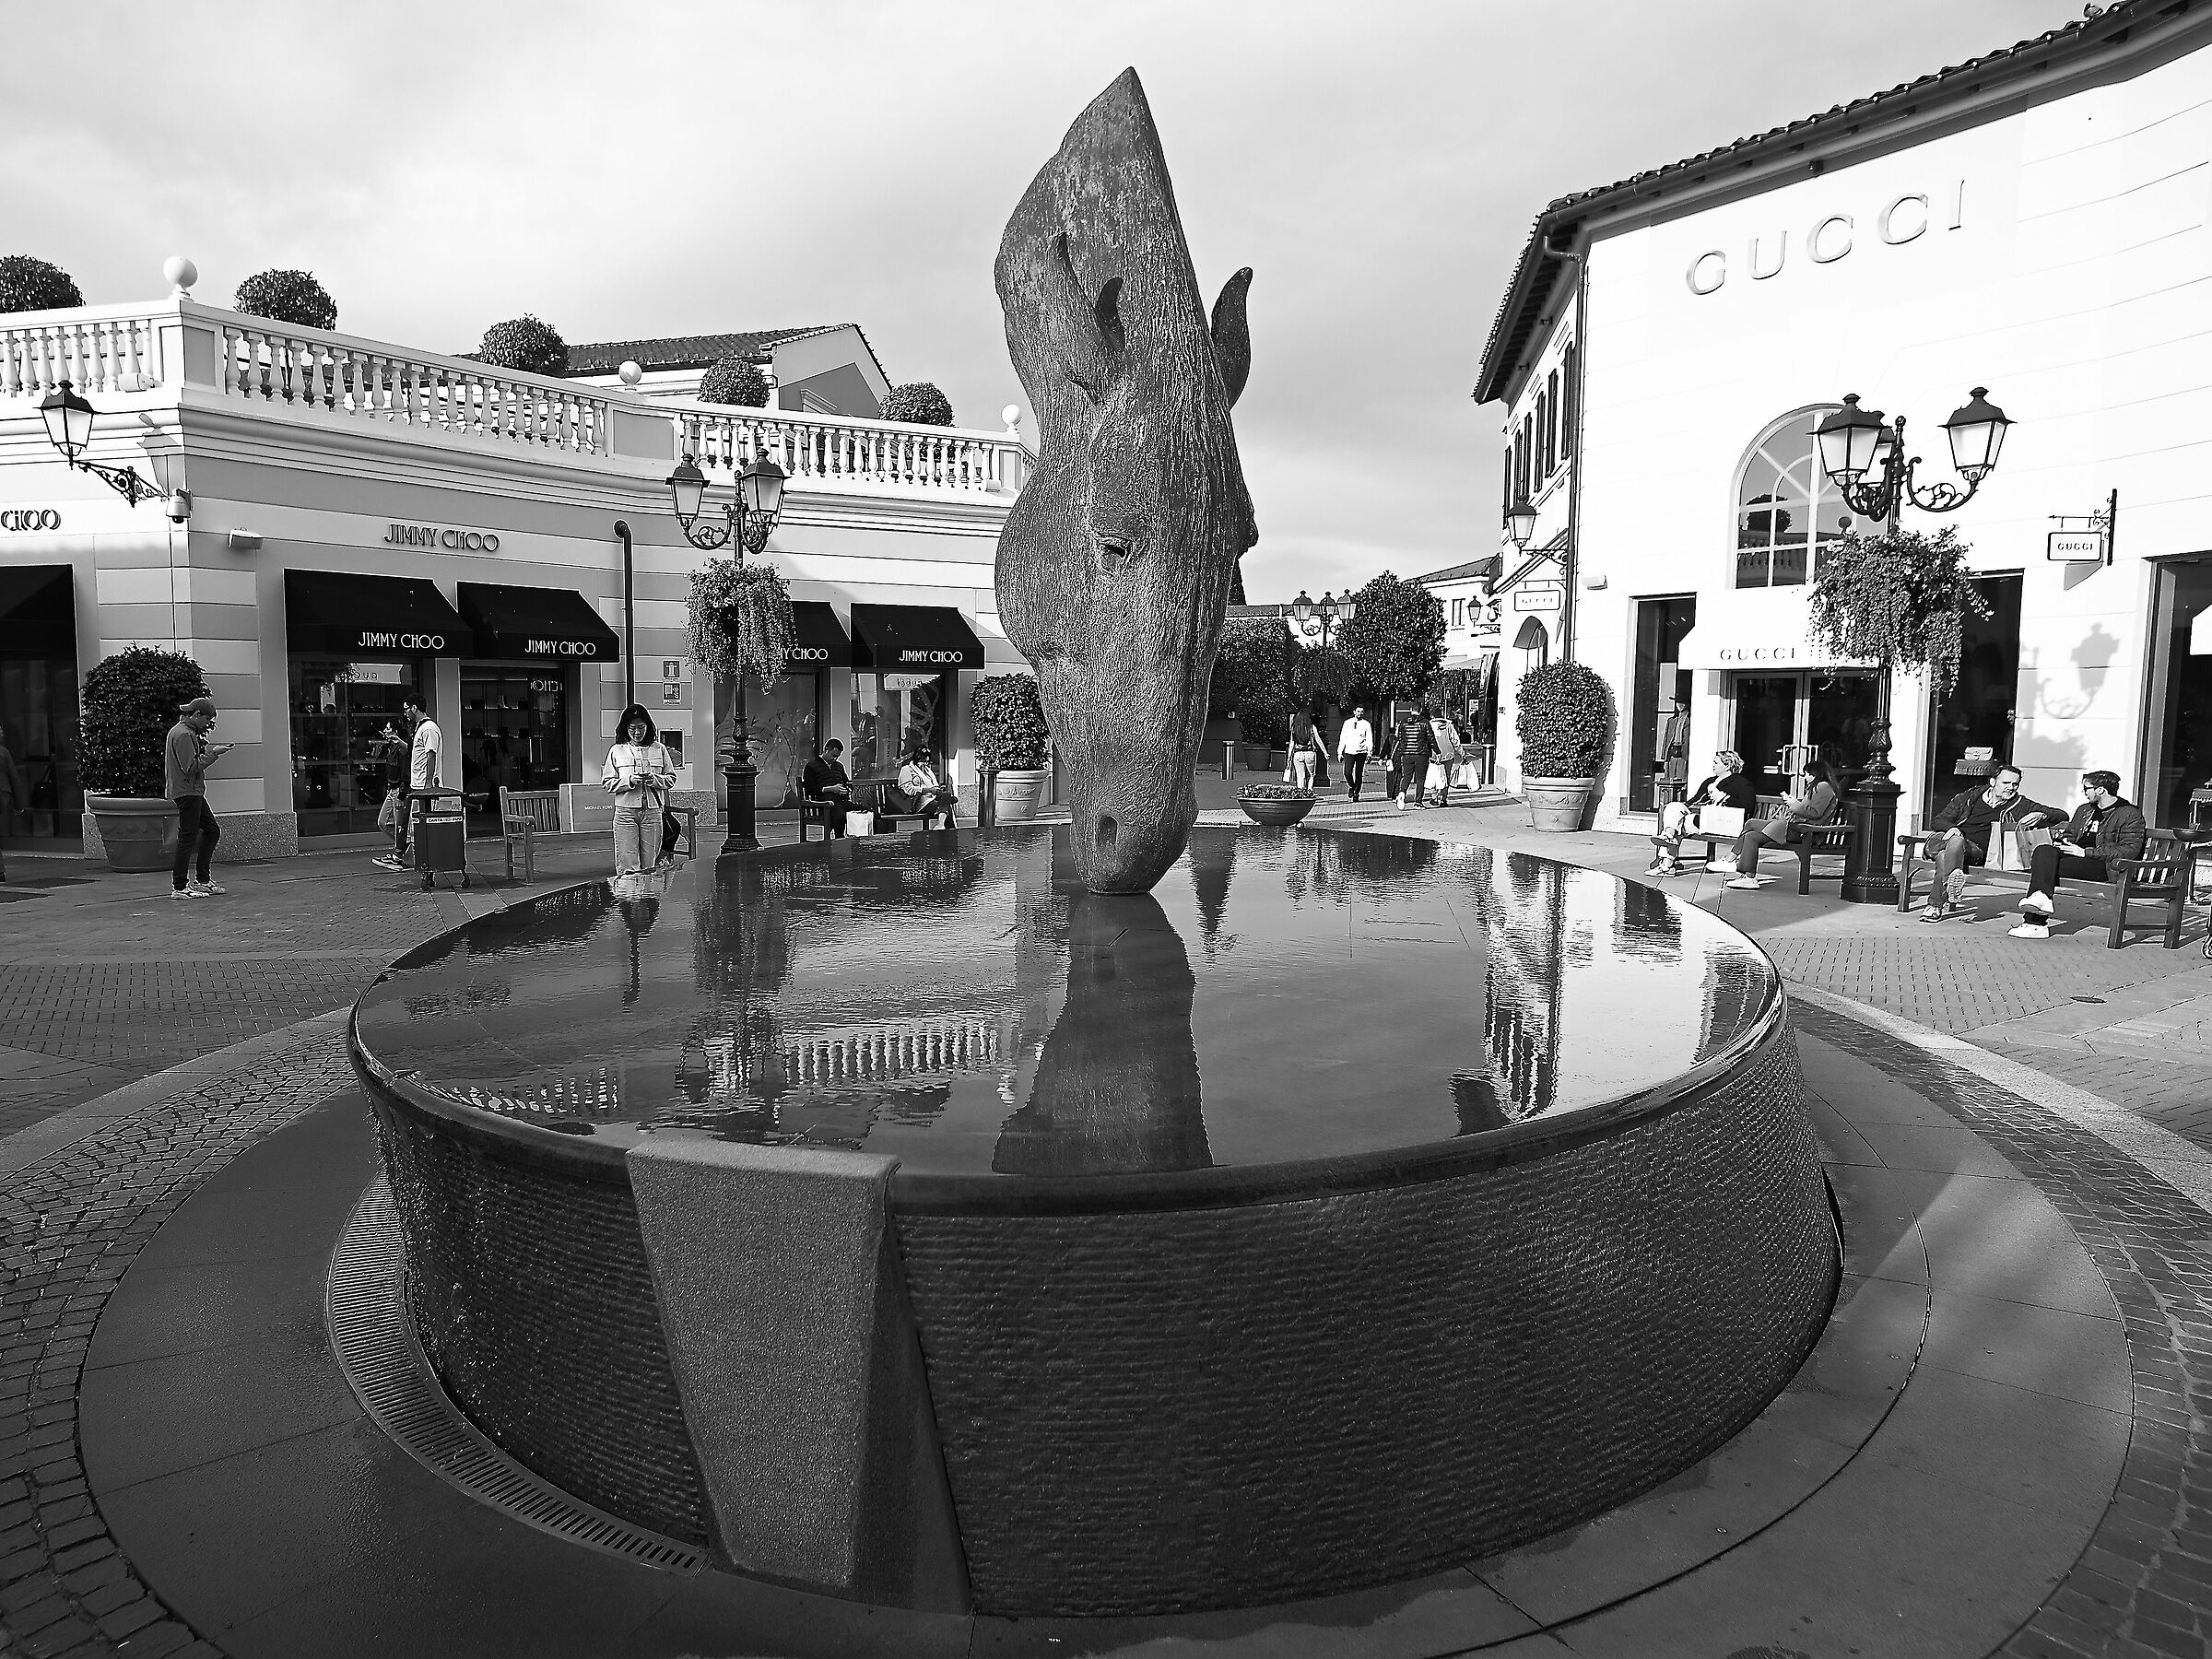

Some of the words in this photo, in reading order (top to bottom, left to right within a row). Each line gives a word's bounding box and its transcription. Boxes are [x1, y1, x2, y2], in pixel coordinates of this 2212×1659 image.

[1686, 179, 1965, 296] GUCCI
[0, 509, 62, 532] CHOO
[383, 523, 438, 547] JIMMY
[441, 529, 500, 552] CHOO
[2057, 543, 2093, 551] GUCCI
[359, 632, 397, 647] JIMMY
[400, 633, 444, 650] CHOO
[524, 640, 557, 654] JIMMY
[559, 641, 596, 655] CHOO
[793, 648, 828, 660] CHOO
[900, 650, 928, 662] JIMMY
[930, 651, 963, 663] CHOO
[1720, 647, 1794, 661] GUCCI
